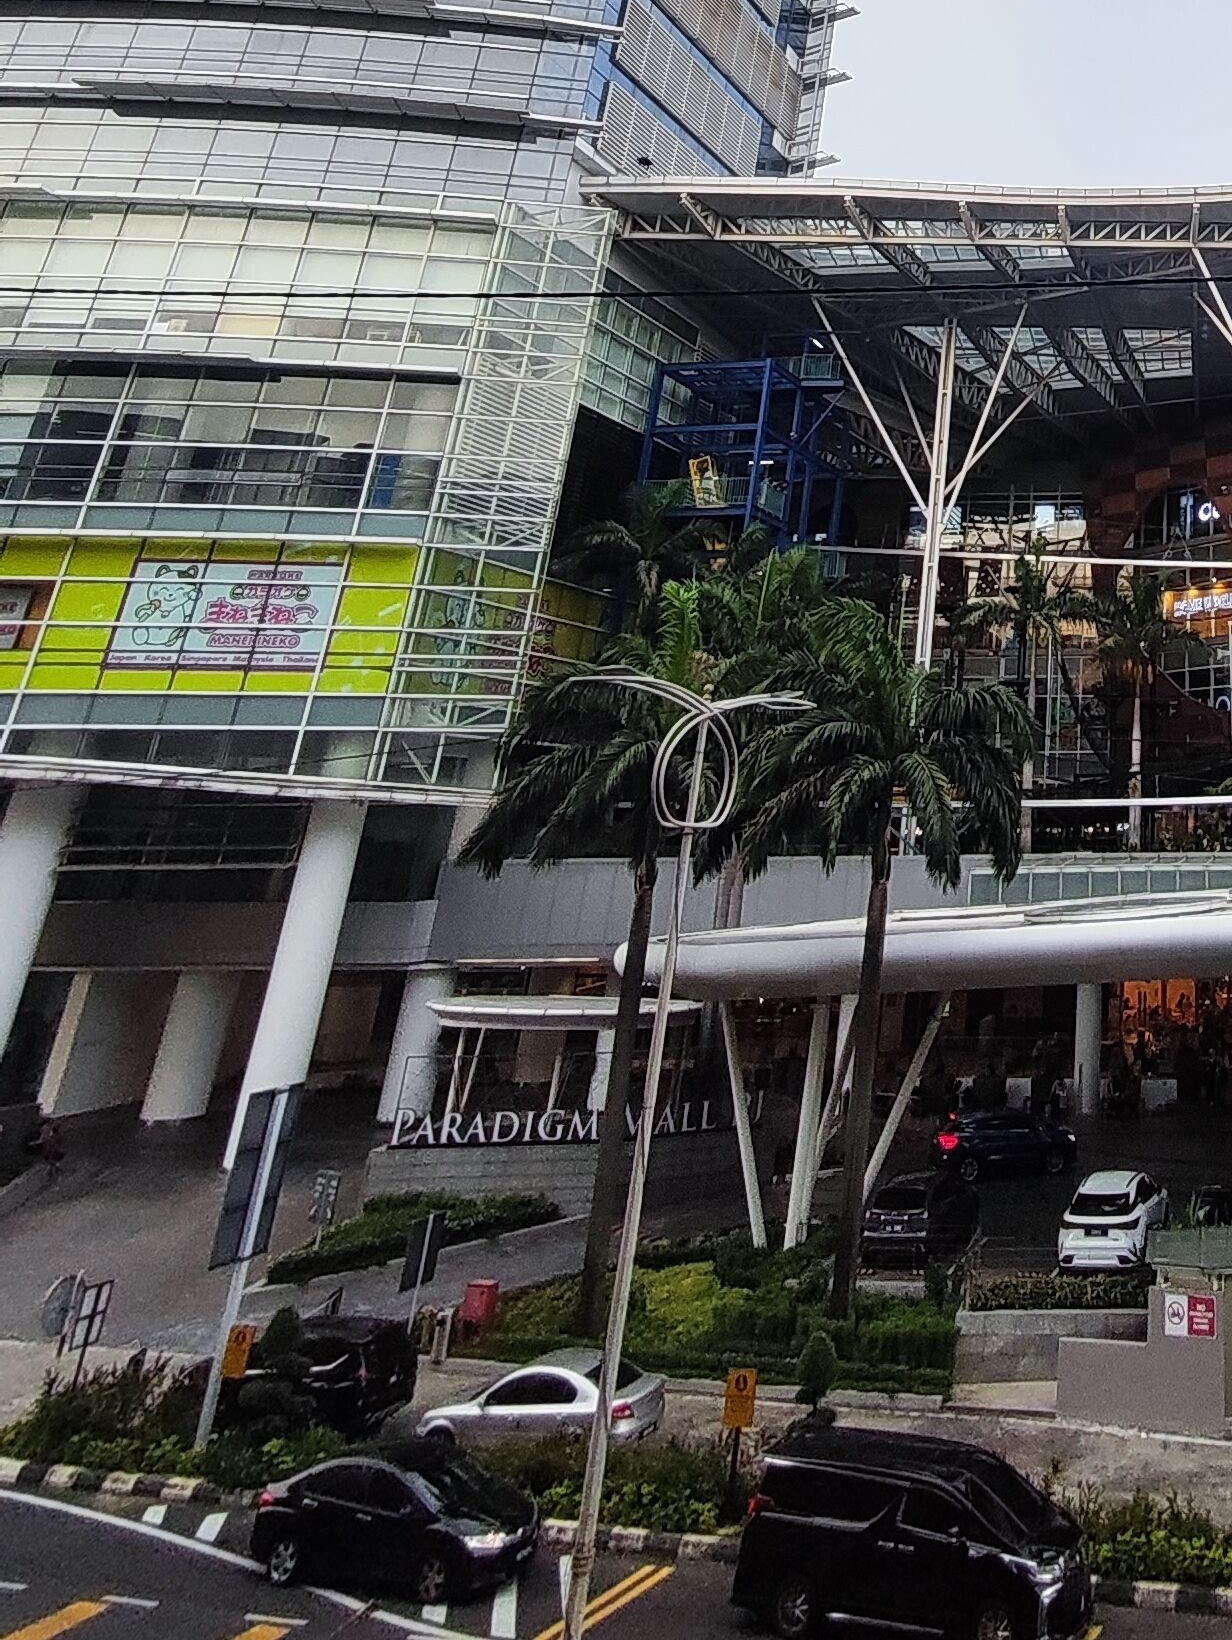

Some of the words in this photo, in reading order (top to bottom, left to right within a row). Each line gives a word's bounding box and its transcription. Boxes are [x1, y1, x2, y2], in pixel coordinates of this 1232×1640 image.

[248, 570, 303, 579] KAROKE
[208, 633, 299, 647] MANEKINEKO
[109, 654, 137, 663] Japan
[143, 654, 172, 662] Korea
[181, 654, 228, 663] Singapore
[232, 655, 274, 663] Maysia
[389, 1107, 600, 1147] PARADIGM
